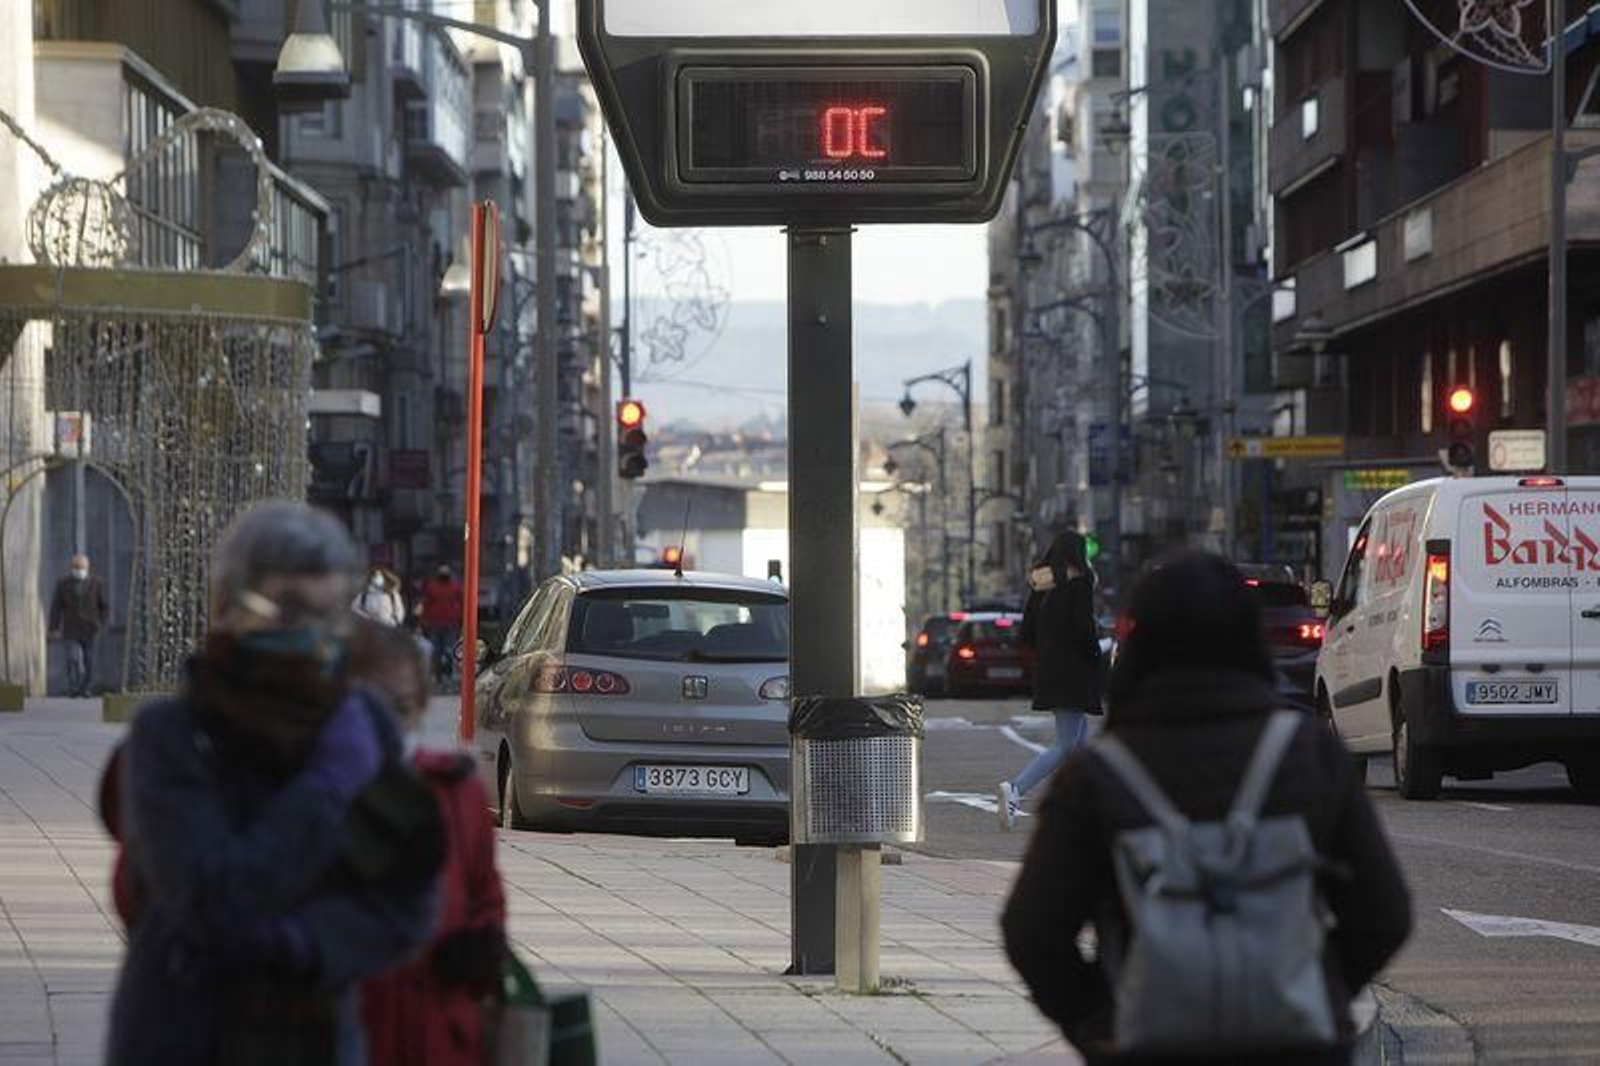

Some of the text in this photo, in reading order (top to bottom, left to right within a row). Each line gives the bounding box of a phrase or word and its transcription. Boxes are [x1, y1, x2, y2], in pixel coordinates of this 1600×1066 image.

[1496, 577, 1579, 588] ALFOMBRAS
[1479, 684, 1553, 700] 9502 JMY
[650, 768, 743, 788] 3873 GCY
